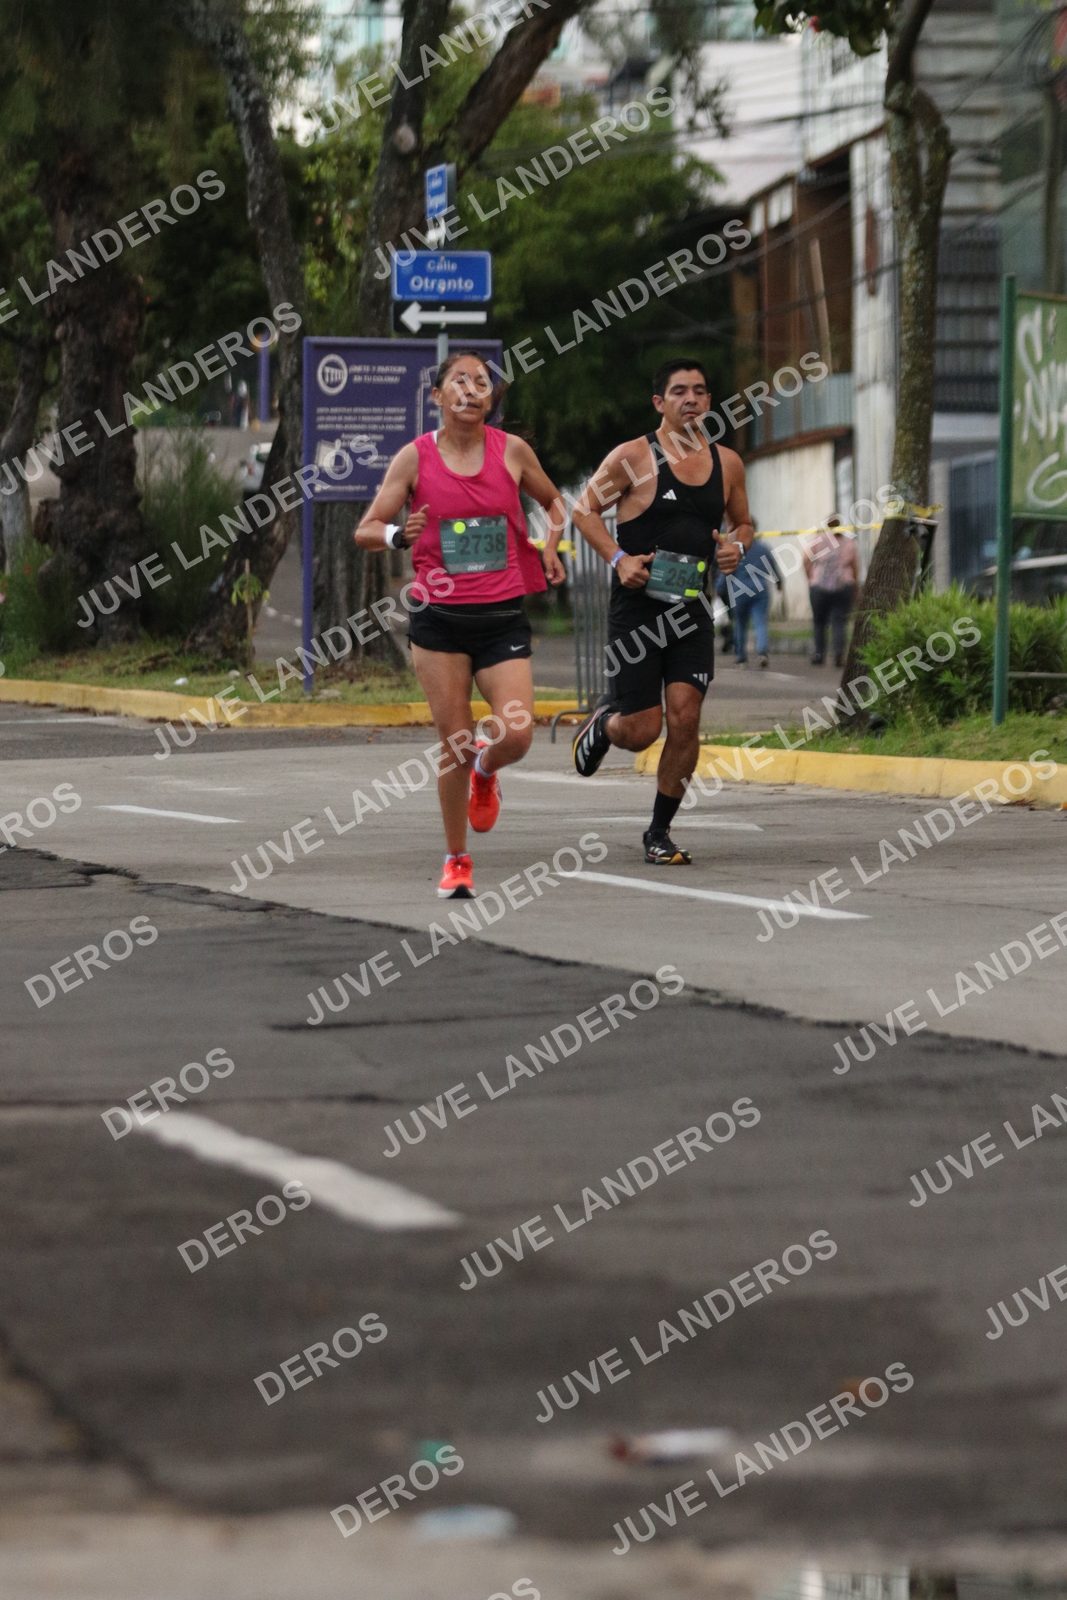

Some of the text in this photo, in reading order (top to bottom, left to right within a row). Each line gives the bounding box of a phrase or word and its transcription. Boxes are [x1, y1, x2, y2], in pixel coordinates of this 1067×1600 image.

[427, 259, 458, 271] Calle
[409, 275, 475, 292] Otranto
[458, 532, 506, 556] 2738
